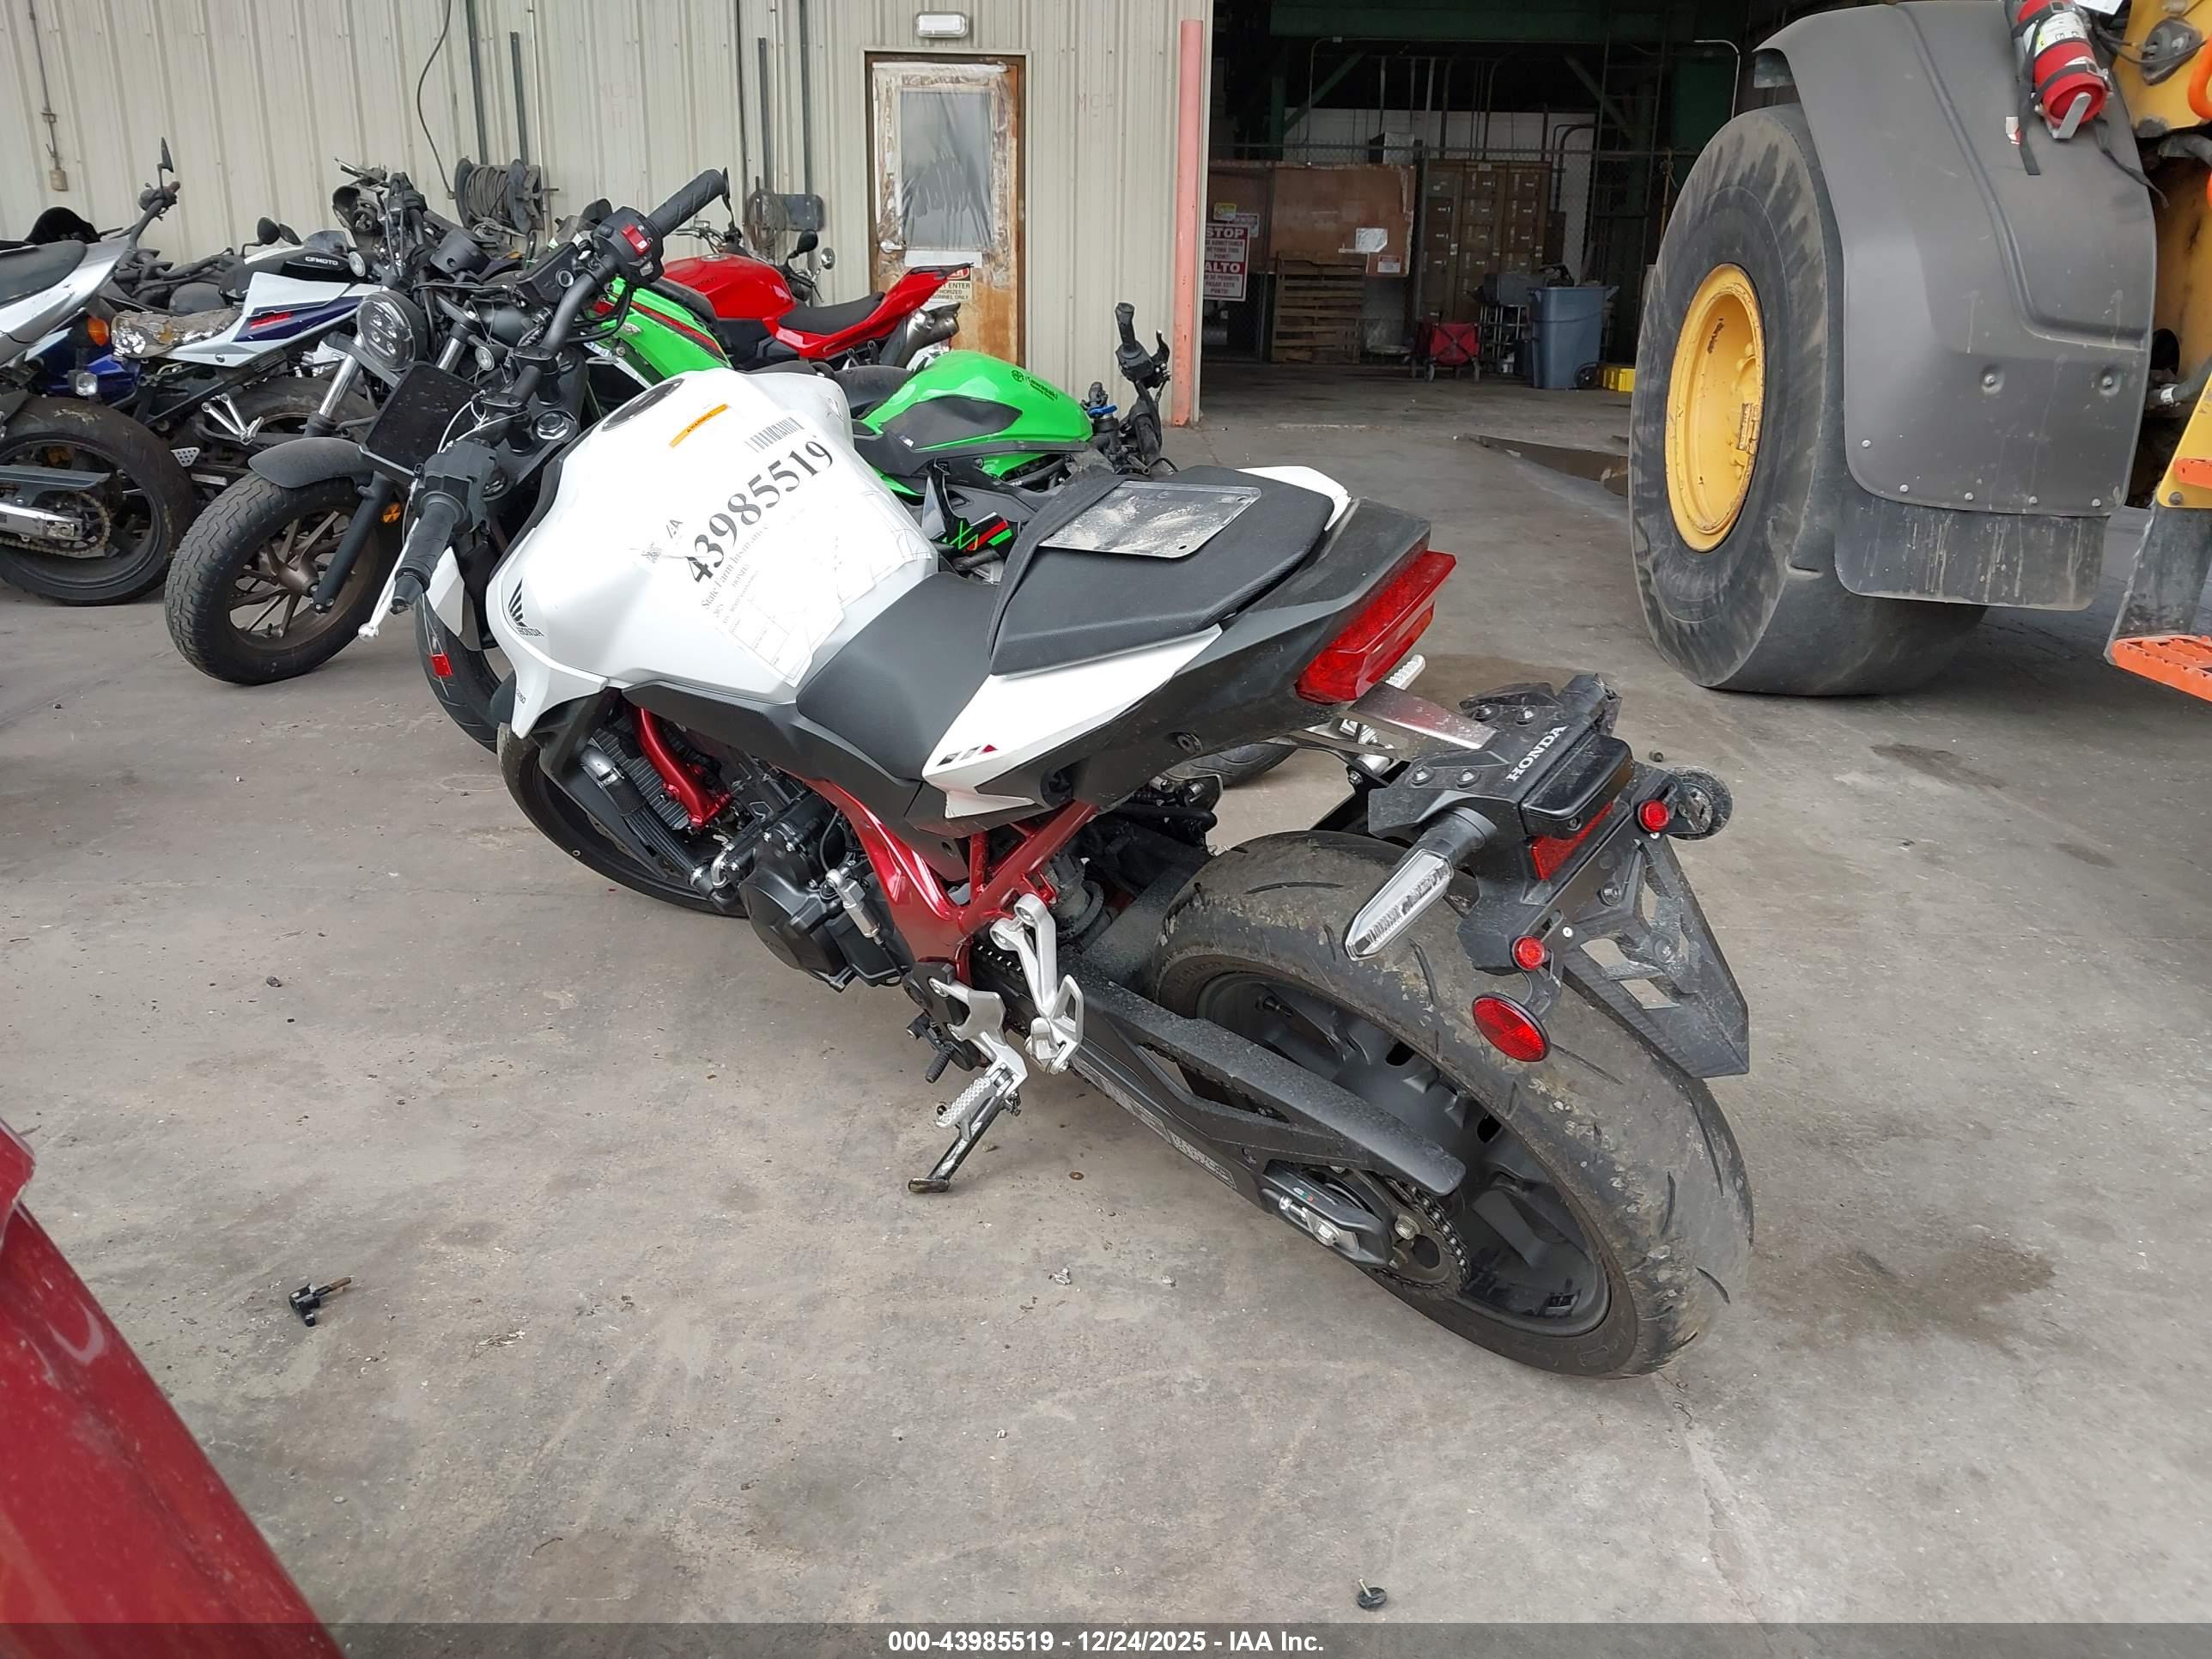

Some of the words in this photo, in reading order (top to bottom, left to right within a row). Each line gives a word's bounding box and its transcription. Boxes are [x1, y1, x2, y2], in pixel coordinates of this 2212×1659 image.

[1206, 228, 1244, 239] STOP
[305, 257, 338, 266] CFMOTO
[1205, 262, 1240, 273] ALTO
[687, 441, 833, 583] 43985519
[517, 627, 544, 637] HONDA
[1506, 725, 1569, 782] HONDA
